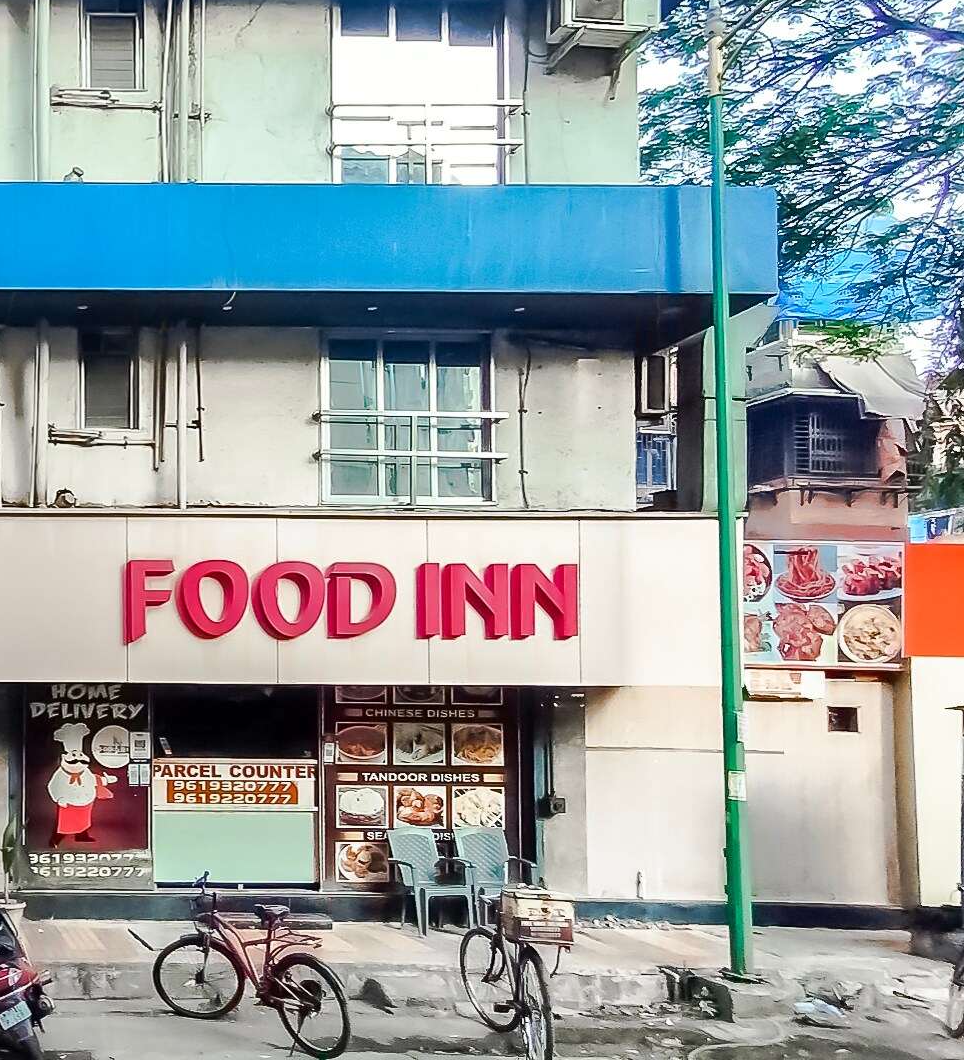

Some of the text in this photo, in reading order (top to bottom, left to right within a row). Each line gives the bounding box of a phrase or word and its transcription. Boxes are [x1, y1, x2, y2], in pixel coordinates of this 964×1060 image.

[123, 559, 579, 644] FOOD INN
[51, 683, 122, 700] HOME
[29, 701, 145, 720] DELIVERY
[365, 708, 475, 718] CHINESE DISHES
[153, 765, 222, 778] PARCEL
[229, 766, 316, 778] COUNTER
[362, 772, 480, 782] TANDOOR DISHES
[173, 781, 292, 792] 9619320777
[173, 793, 292, 804] 9619220777
